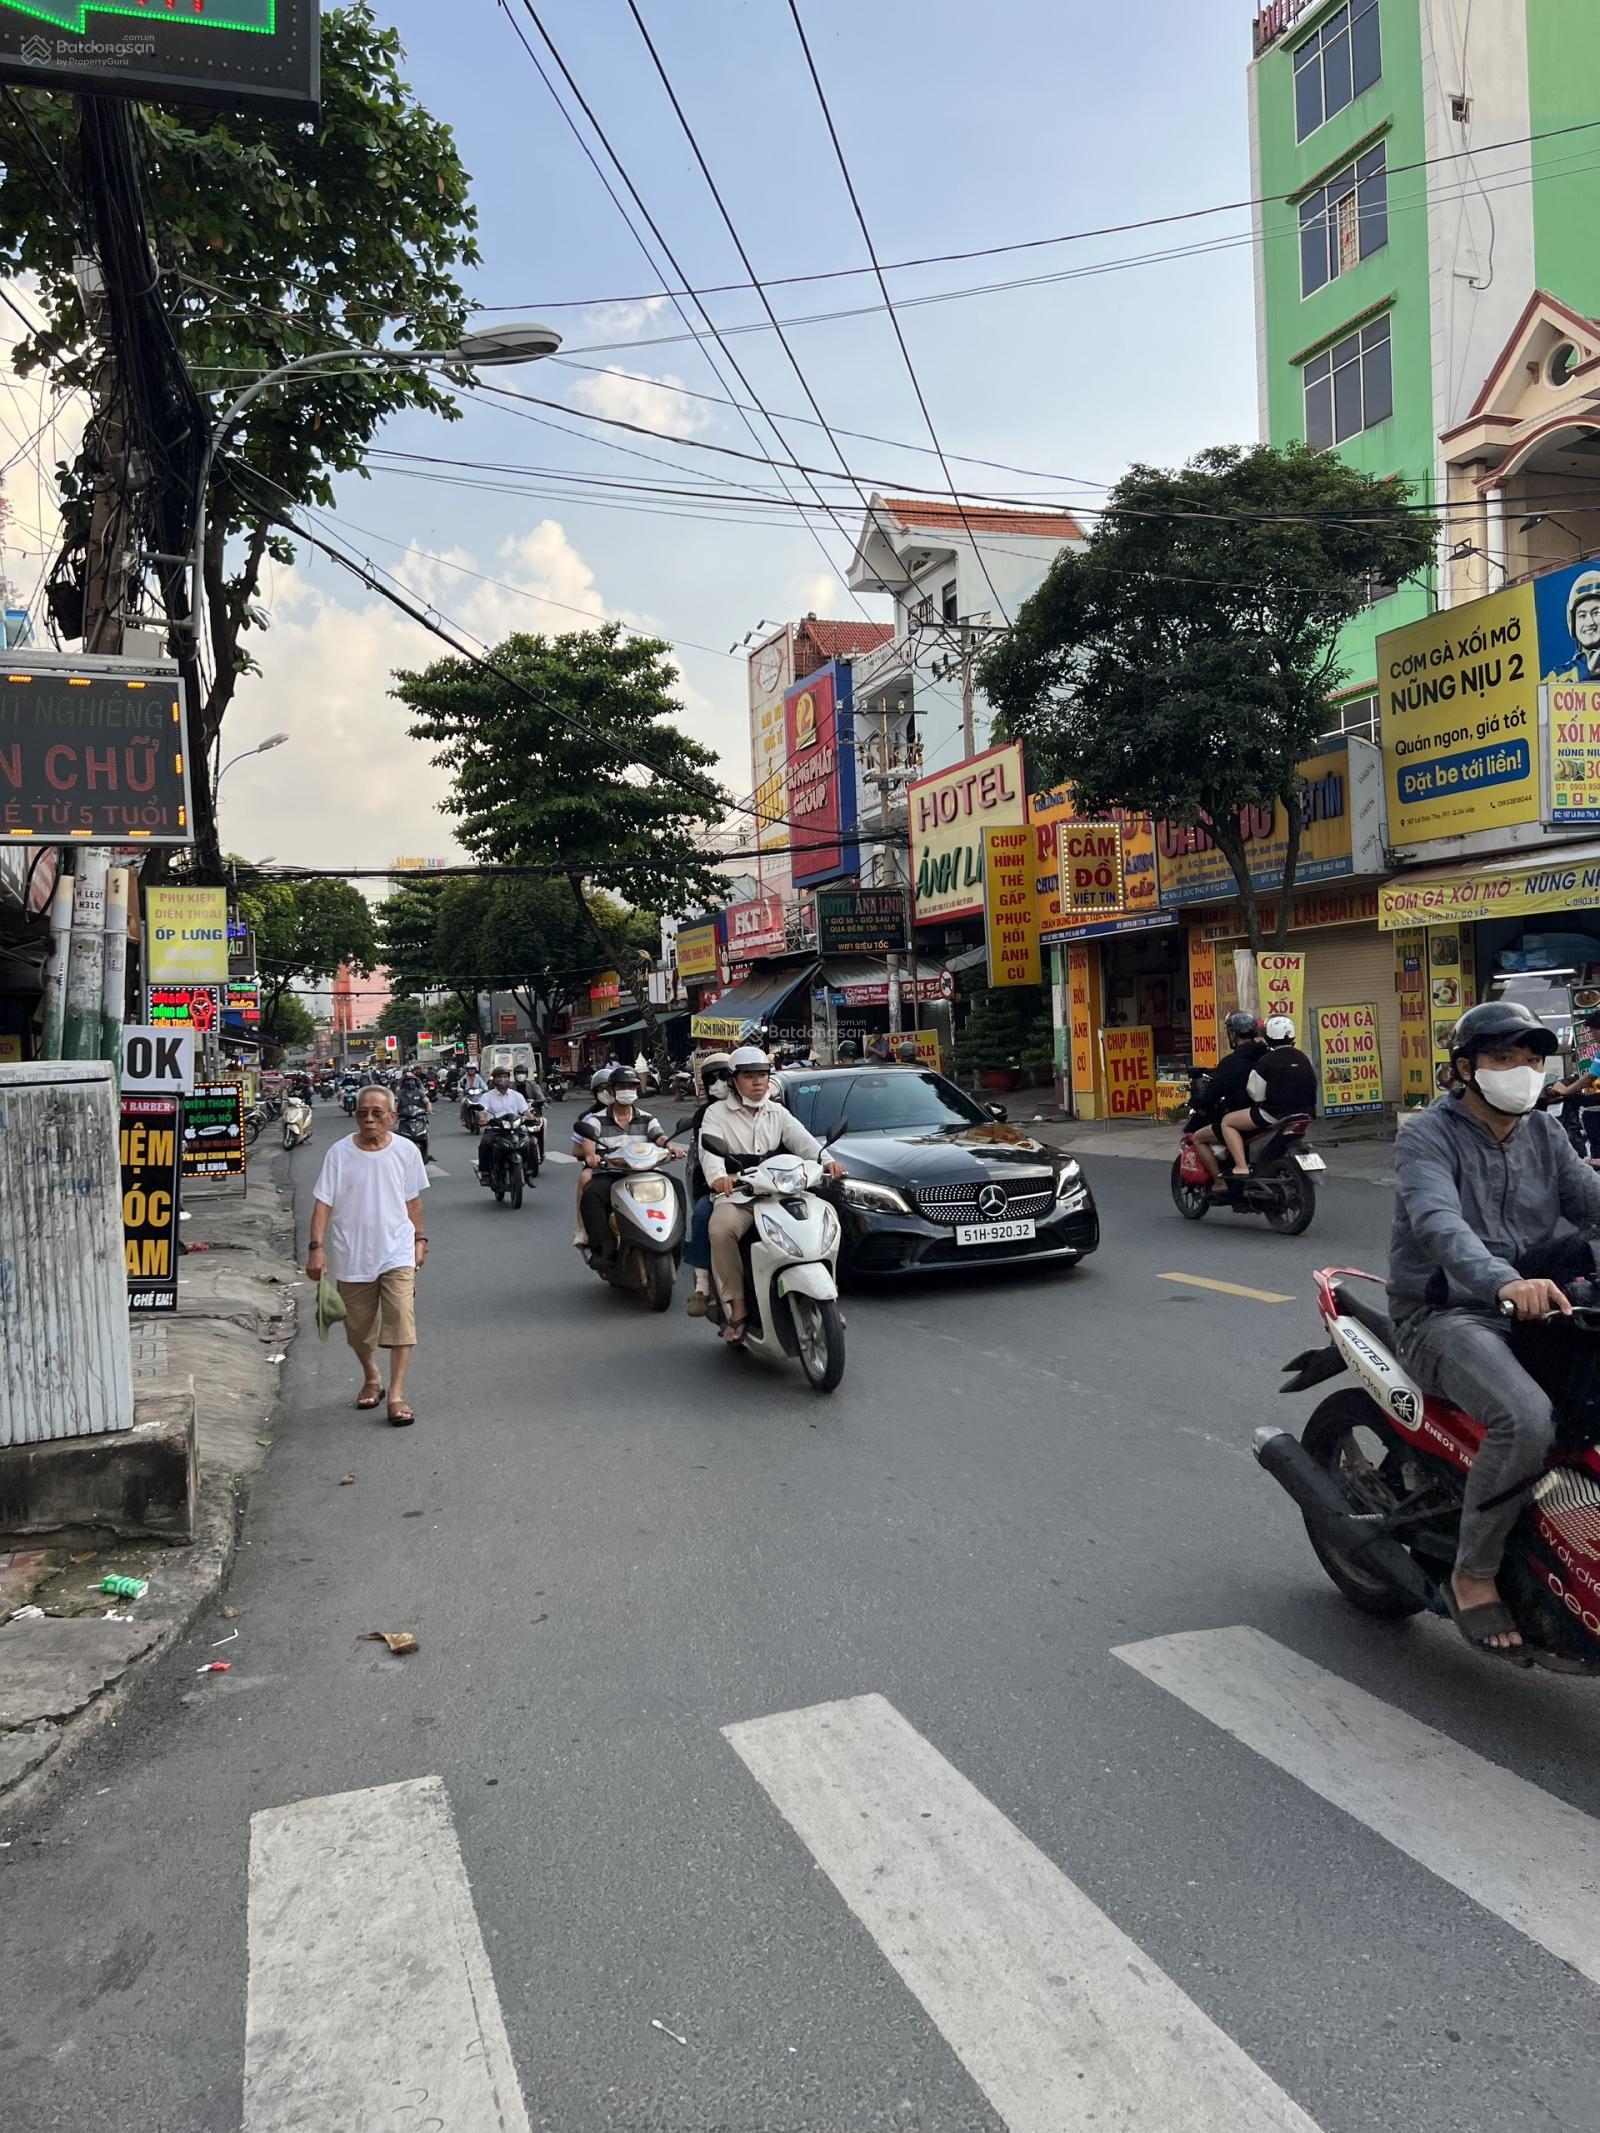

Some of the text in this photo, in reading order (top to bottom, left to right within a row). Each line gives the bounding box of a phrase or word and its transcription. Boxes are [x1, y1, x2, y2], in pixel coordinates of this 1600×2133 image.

[1390, 617, 1521, 679] CƠM GÀ XỐI MỠ
[1391, 653, 1525, 715] NŨNG NỊU 2
[35, 690, 163, 729] NGHIÊNG
[1554, 689, 1586, 712] CƠM
[1395, 705, 1526, 756] Quán ngon, giá tốt
[1557, 714, 1600, 743] XỐI M
[45, 735, 160, 792] CHỮ
[1404, 749, 1522, 796] Đặt be tới liền!
[918, 763, 1015, 832] HOTEL
[31, 798, 72, 824] TỪ
[80, 806, 93, 824] 5
[102, 795, 168, 826] TUỔI
[991, 834, 1027, 850] CHỤP
[1068, 829, 1116, 858] CẦM
[994, 852, 1025, 868] HÌNH
[1000, 870, 1024, 887] THẺ
[1075, 859, 1113, 888] ĐỒ
[999, 890, 1026, 906] GẤP
[1074, 892, 1096, 905] VIỆT
[1384, 892, 1418, 912] CƠM
[1423, 884, 1444, 907] GÀ
[1450, 877, 1478, 903] XỐI
[1525, 871, 1576, 895] NŨNG
[1582, 869, 1600, 892] NỊ
[875, 915, 890, 923] SAU
[996, 911, 1031, 927] PHỤC
[155, 925, 222, 940] ỐP LƯNG
[1003, 928, 1024, 943] HỒI
[874, 939, 888, 949] TỐC
[1001, 946, 1029, 962] ẢNH
[1008, 964, 1025, 980] CŨ
[1260, 956, 1301, 970] CƠM
[1193, 968, 1213, 988] HÌNH
[1269, 976, 1290, 992] GÀ
[1193, 1000, 1215, 1020] CHÂN
[1268, 997, 1295, 1014] XỐI
[1320, 1006, 1374, 1029] CƠM GÀ
[1195, 1035, 1216, 1053] DUNG
[1325, 1030, 1373, 1055] XỐI MỠ
[121, 1036, 184, 1079] OK
[1110, 1050, 1150, 1083] THẺ
[1352, 1064, 1377, 1081] 30K
[130, 1101, 170, 1112] BARBER
[1111, 1083, 1152, 1114] GẤP
[964, 1224, 1029, 1242] 51H-920.32
[133, 1291, 173, 1306] GHÉ EM!
[1342, 1329, 1390, 1372] EXCITER
[1424, 1421, 1454, 1452] ENEOS
[1541, 1517, 1557, 1546] by
[1549, 1573, 1600, 1636] bea
